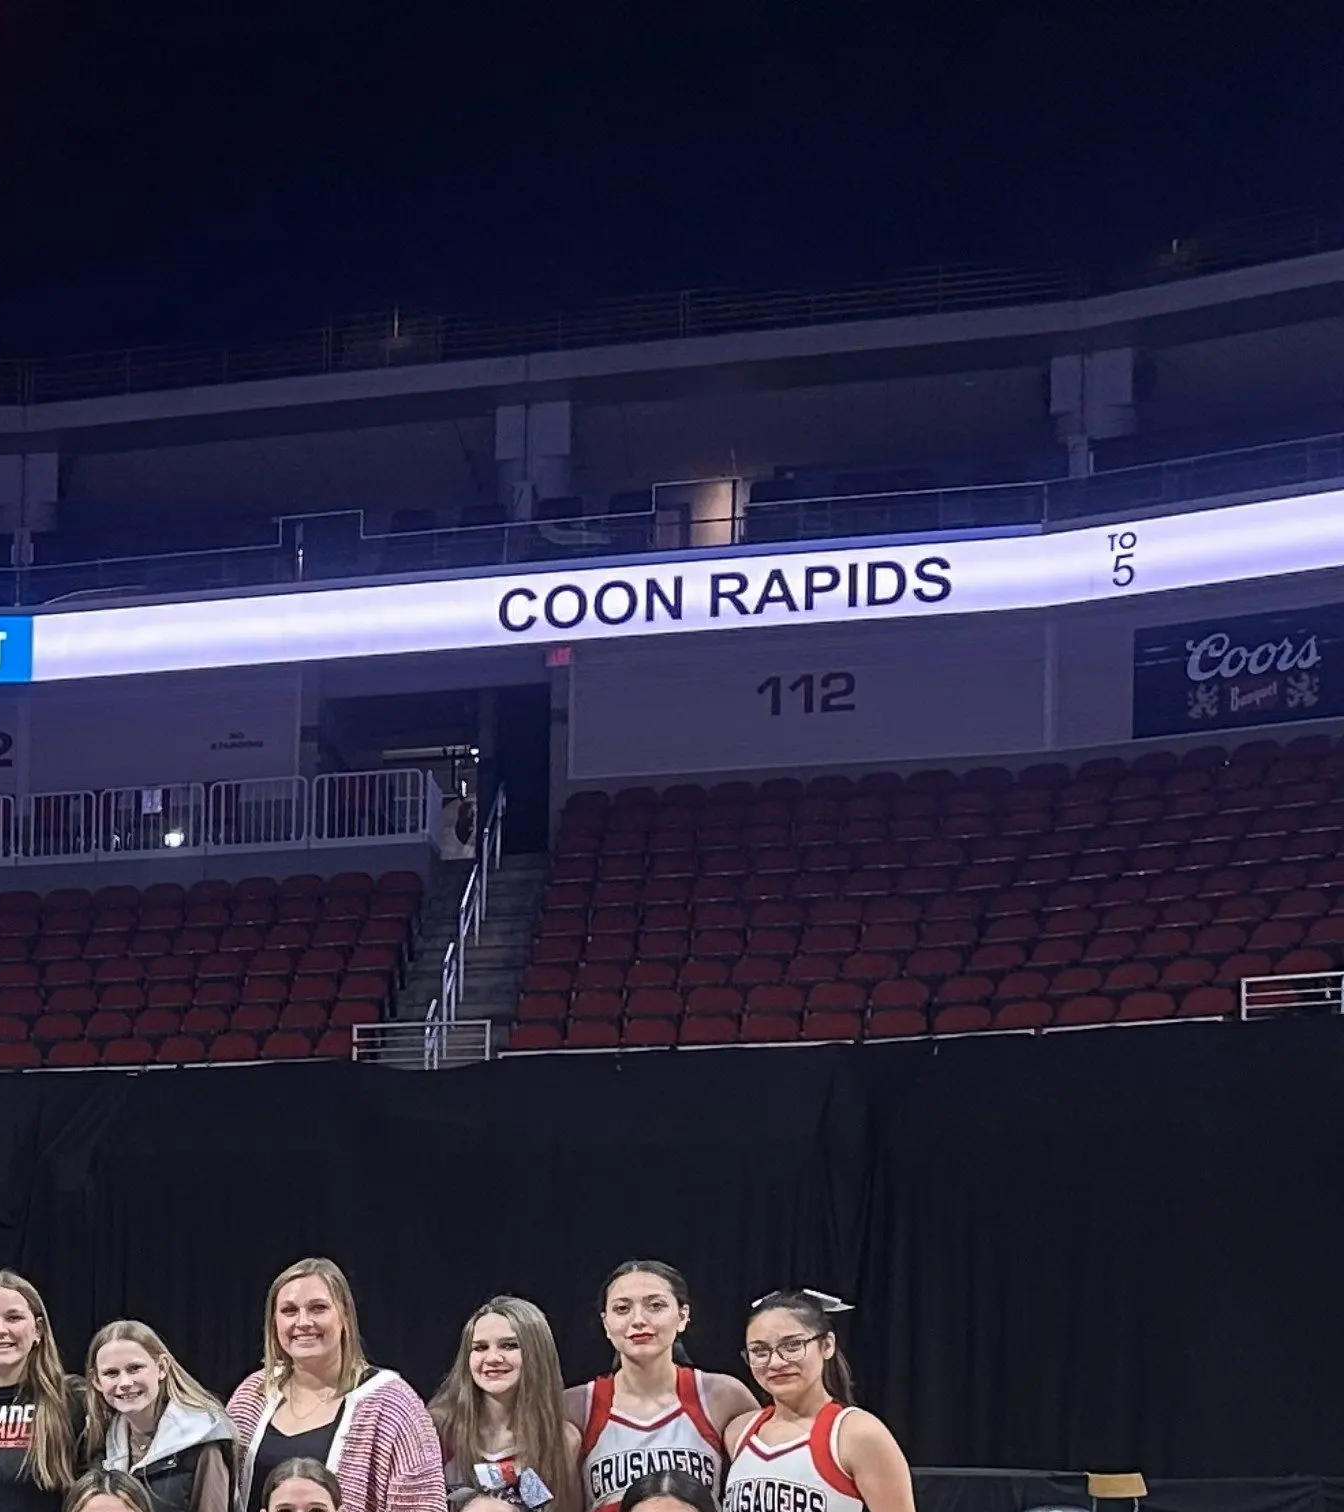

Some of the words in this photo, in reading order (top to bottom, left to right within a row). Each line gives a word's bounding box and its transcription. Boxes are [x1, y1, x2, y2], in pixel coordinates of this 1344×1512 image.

[1108, 532, 1137, 551] TO
[1112, 553, 1135, 587] 5
[499, 576, 685, 634] COON
[711, 556, 953, 618] RAPIDS
[1186, 632, 1321, 682] Coors
[756, 671, 856, 717] 112
